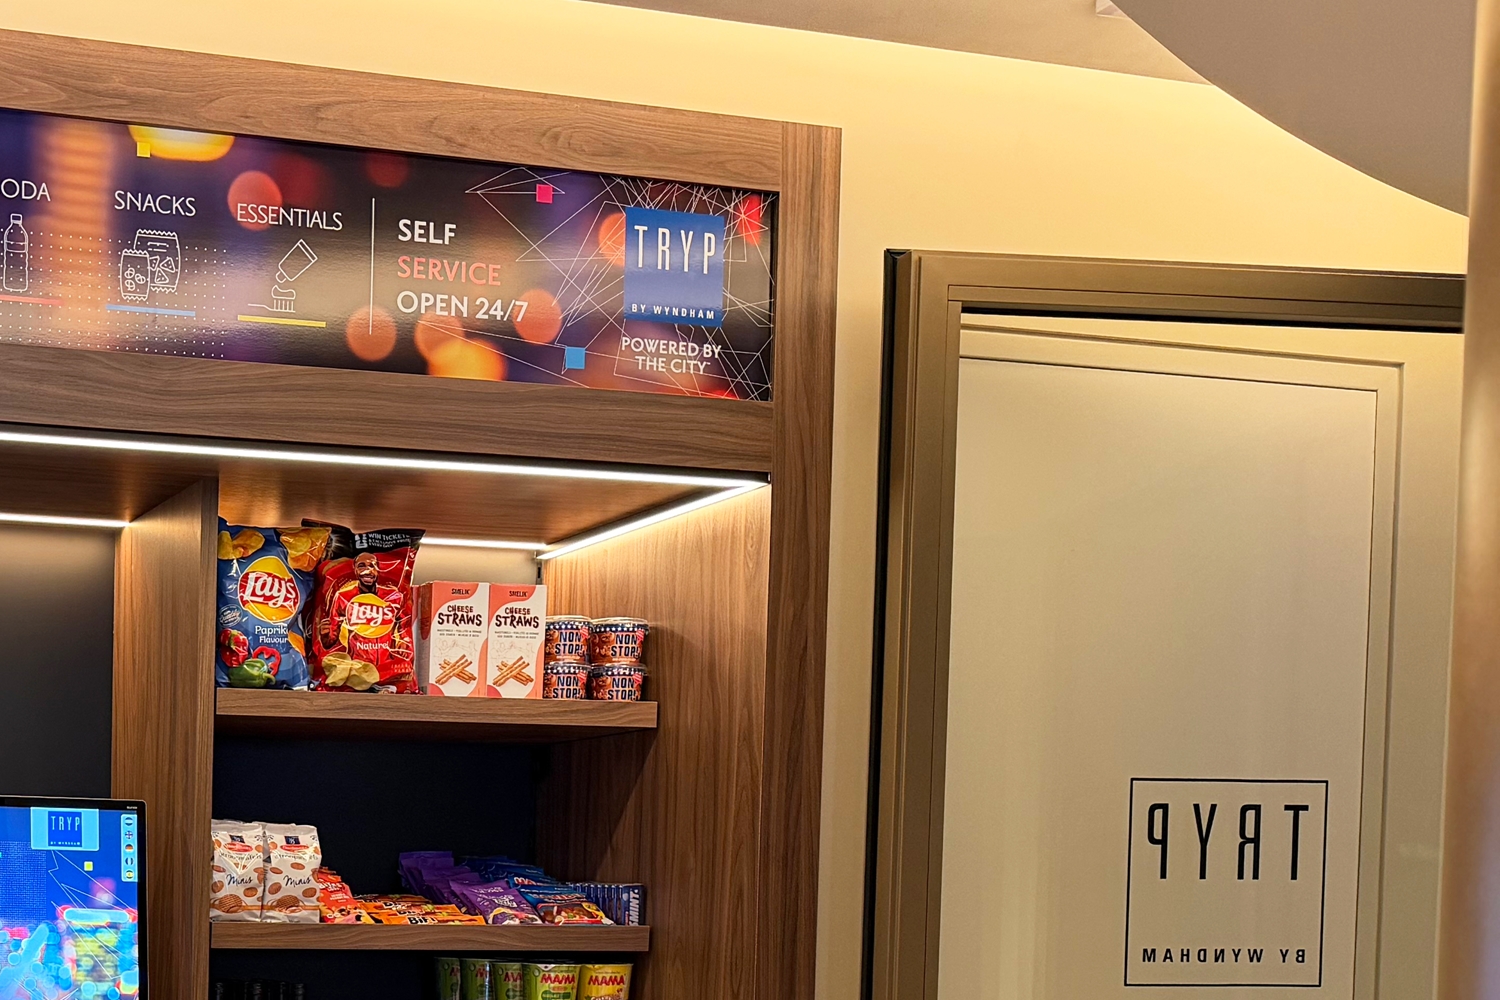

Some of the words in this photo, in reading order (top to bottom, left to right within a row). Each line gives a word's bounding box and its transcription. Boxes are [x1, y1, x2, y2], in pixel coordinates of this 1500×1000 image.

[114, 190, 197, 217] SNACKS
[237, 203, 343, 231] ESSENTIALS
[398, 219, 457, 245] SELF
[634, 225, 716, 275] TRYP
[397, 255, 501, 286] SERVICE
[396, 291, 468, 318] OPEN
[475, 299, 528, 322] 24/7
[631, 303, 646, 313] BY
[653, 305, 715, 320] WYNDHAM
[621, 337, 699, 357] POWERED
[703, 344, 721, 359] BY
[635, 356, 667, 371] THE
[447, 605, 473, 613] CHEESE
[505, 607, 531, 616] CHEESE
[437, 612, 482, 626] STRAWS
[495, 615, 539, 629] STRAWS
[559, 631, 581, 642] NON
[615, 633, 638, 645] NON
[557, 676, 579, 688] NON
[612, 677, 634, 688] NON
[50, 814, 81, 831] TRYP
[540, 974, 575, 984] MAMA
[588, 974, 625, 986] MAMA
